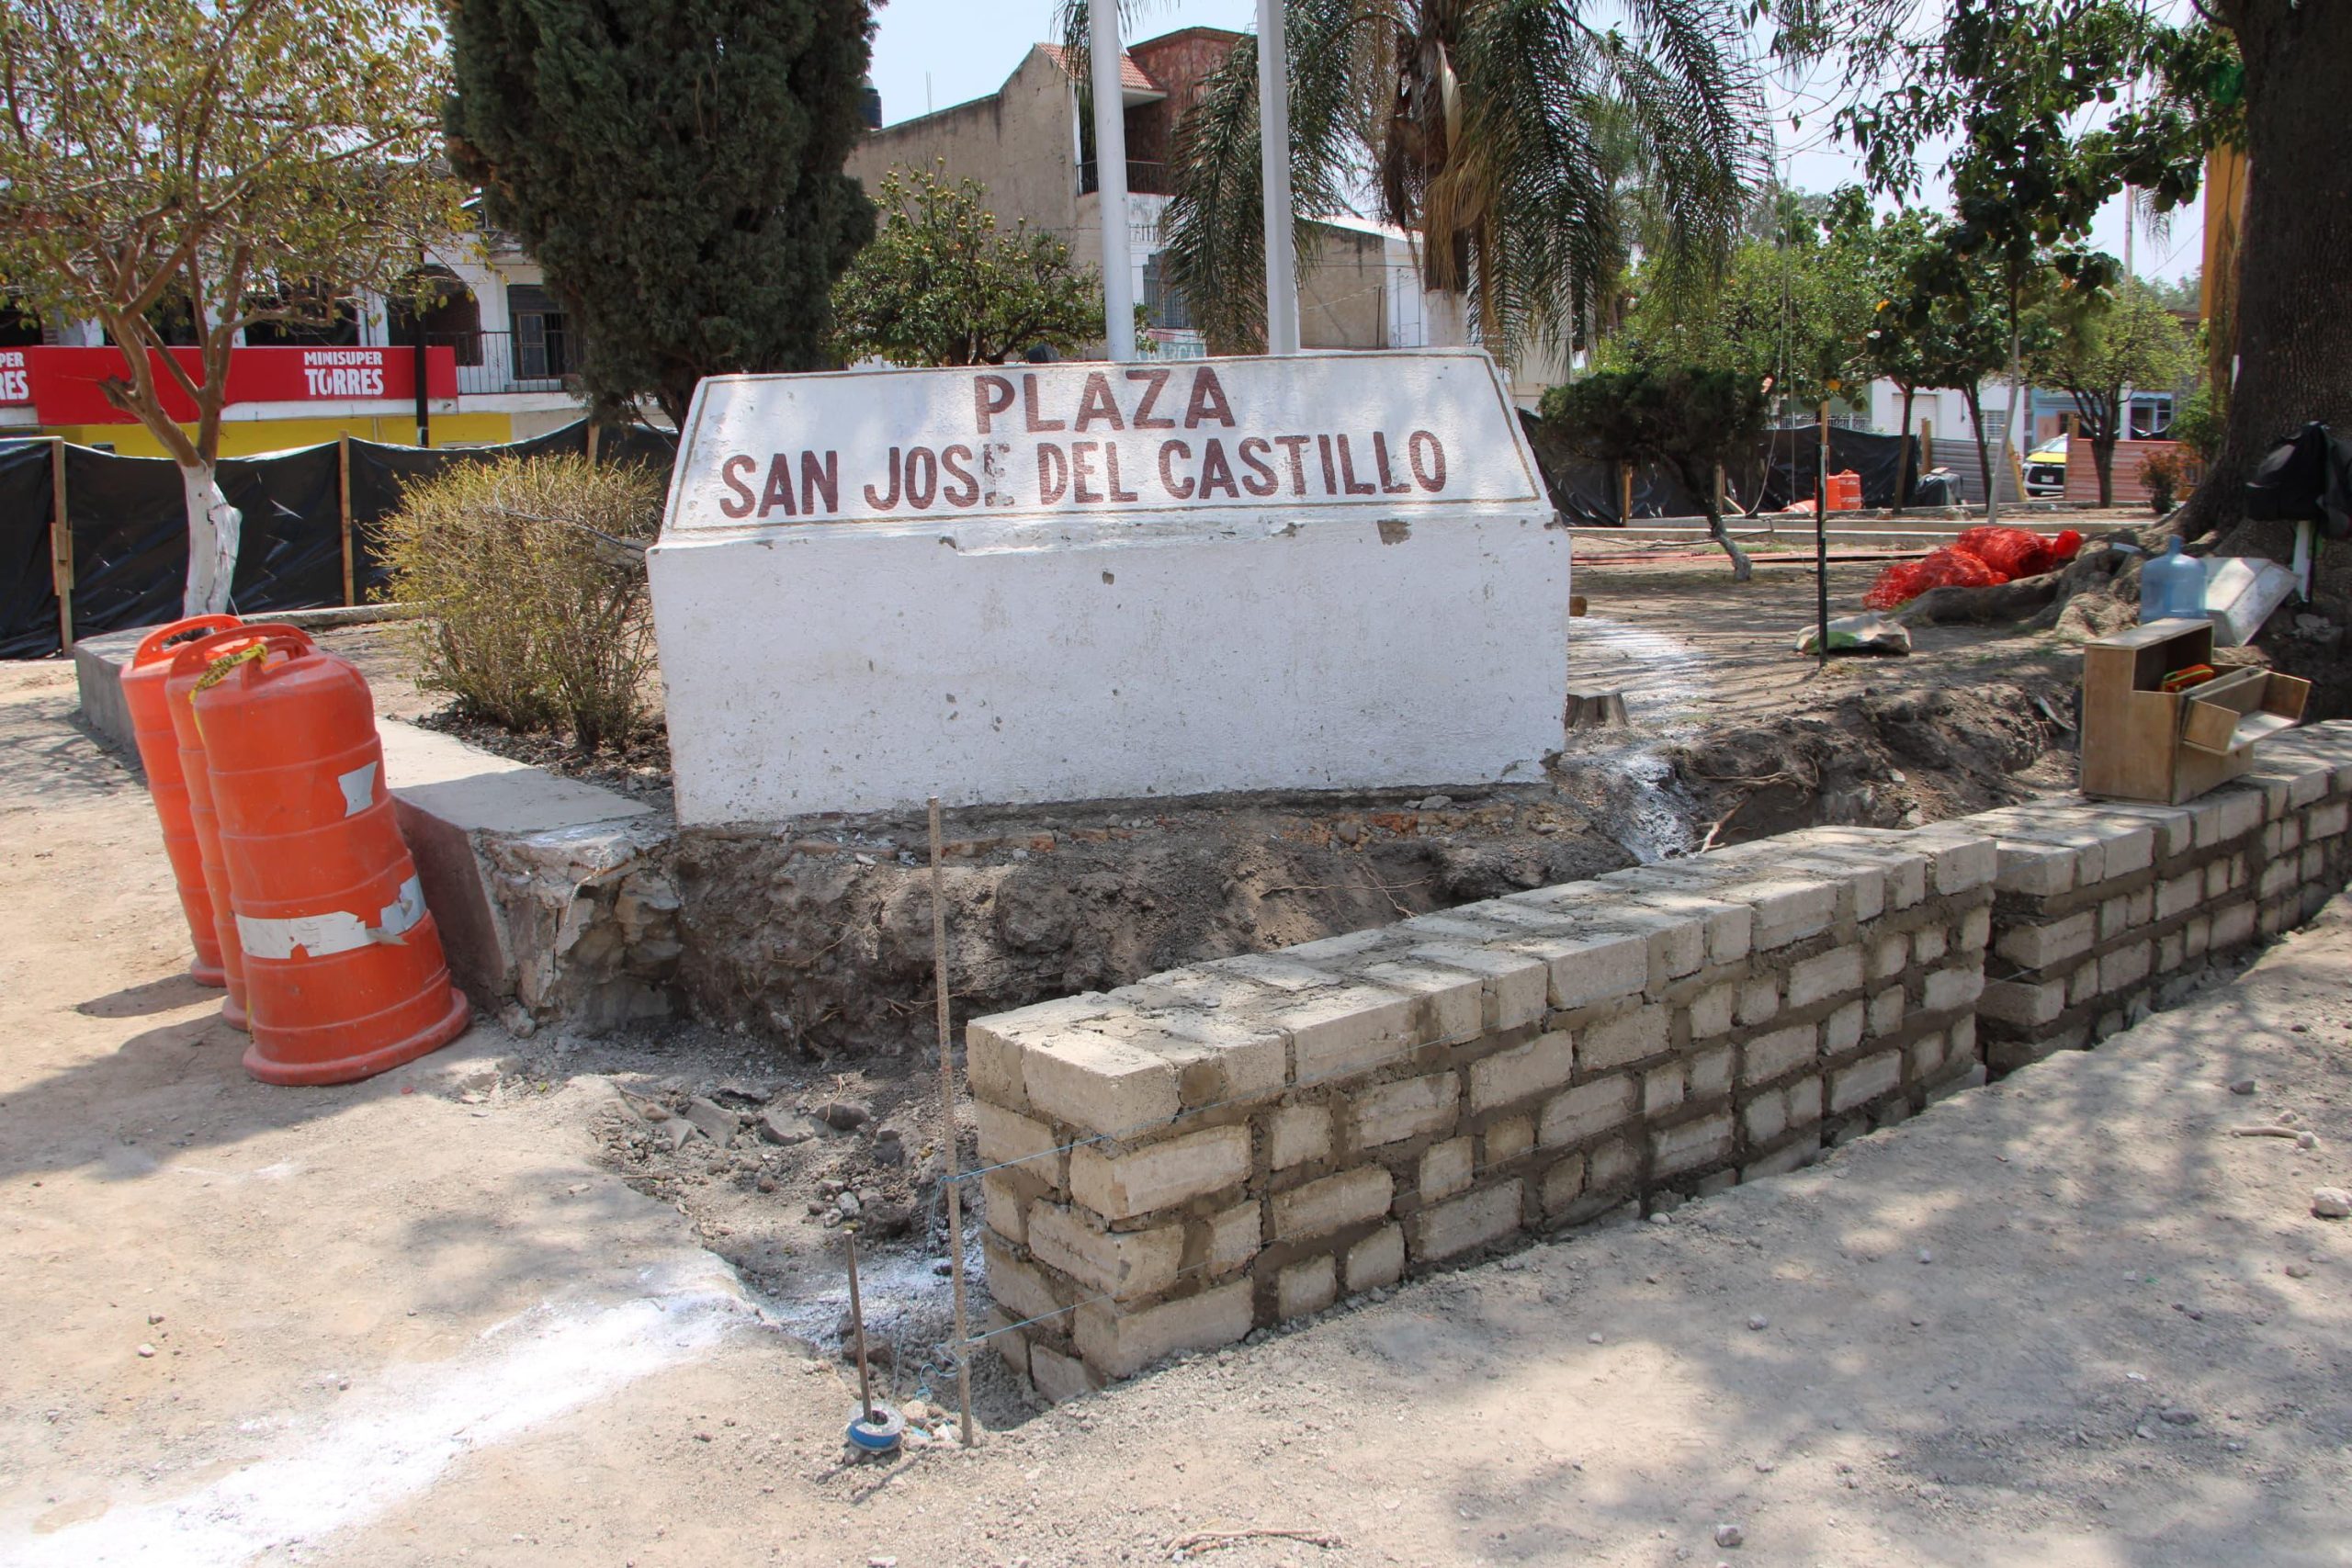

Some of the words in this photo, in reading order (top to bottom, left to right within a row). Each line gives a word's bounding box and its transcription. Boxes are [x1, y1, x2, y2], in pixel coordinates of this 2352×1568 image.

[304, 351, 383, 366] MINISUPER
[304, 368, 384, 395] TORRES
[974, 367, 1236, 434] PLAZA
[719, 450, 839, 519] SAN
[864, 443, 1014, 511] JOSE
[1037, 441, 1138, 505] DEL
[1159, 430, 1447, 499] CASTILLO
